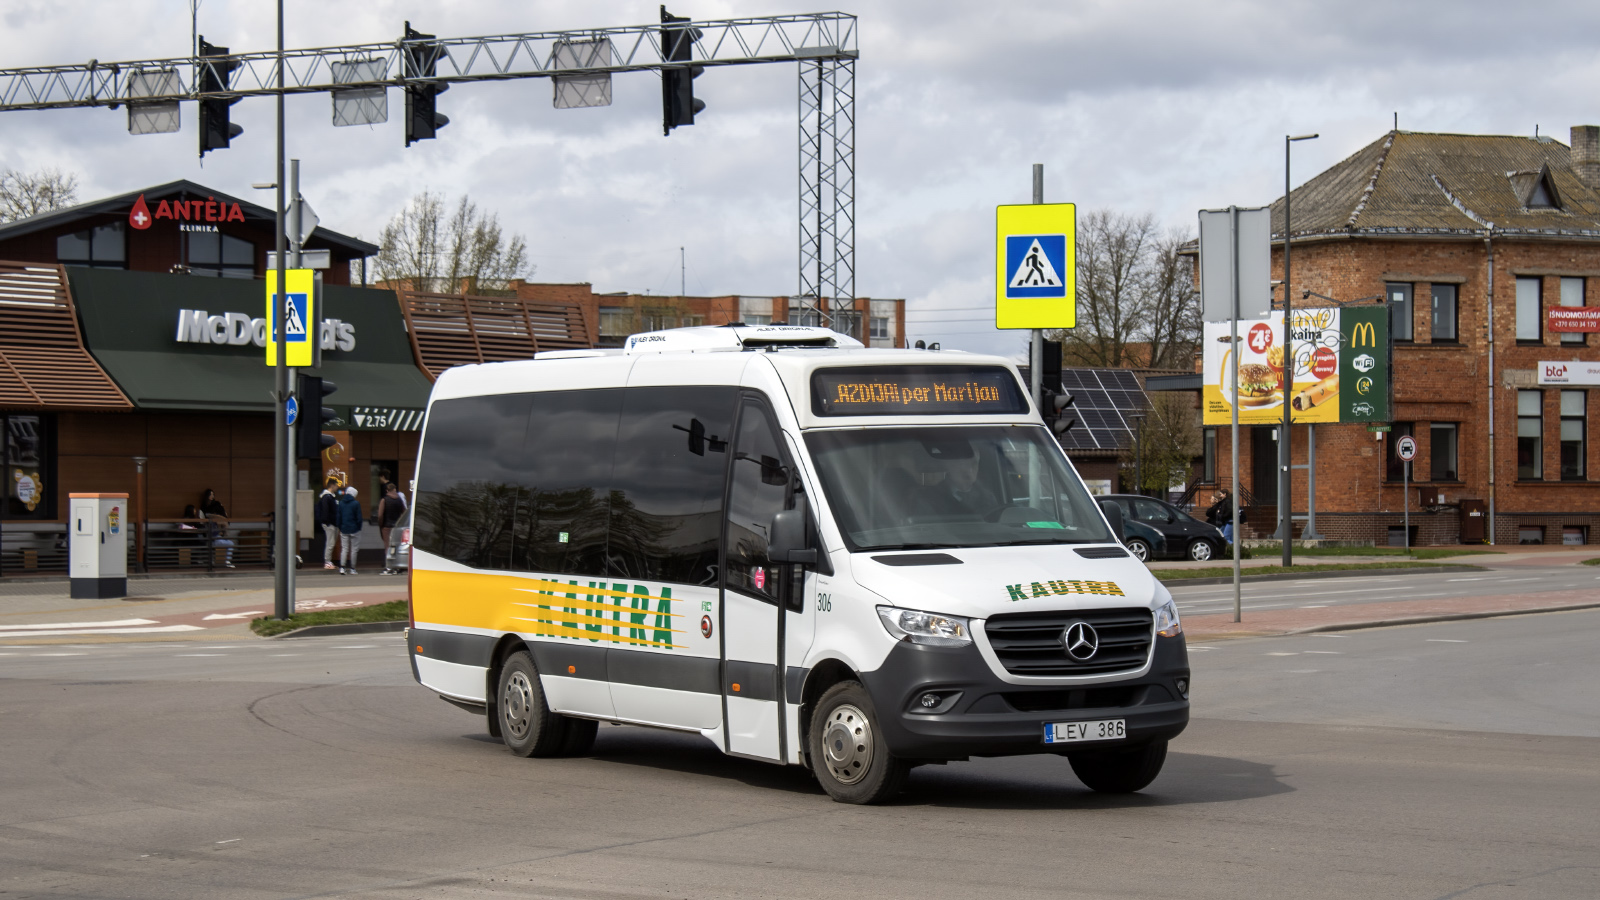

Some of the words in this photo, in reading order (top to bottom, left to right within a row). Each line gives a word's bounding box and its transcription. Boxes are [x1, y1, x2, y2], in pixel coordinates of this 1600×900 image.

[155, 196, 245, 223] ANTĖJA
[179, 224, 220, 233] KLINIKA
[176, 309, 356, 352] McDod's
[1291, 328, 1322, 340] kaina
[1546, 365, 1563, 377] bta
[834, 383, 900, 403] AZDIJAI
[902, 386, 931, 405] per
[366, 415, 387, 428] 2.75
[1005, 579, 1126, 602] KAUTRA
[817, 592, 832, 612] 306
[536, 578, 673, 650] KAUTRA
[1055, 723, 1087, 740] LEV
[1098, 720, 1124, 738] 386
